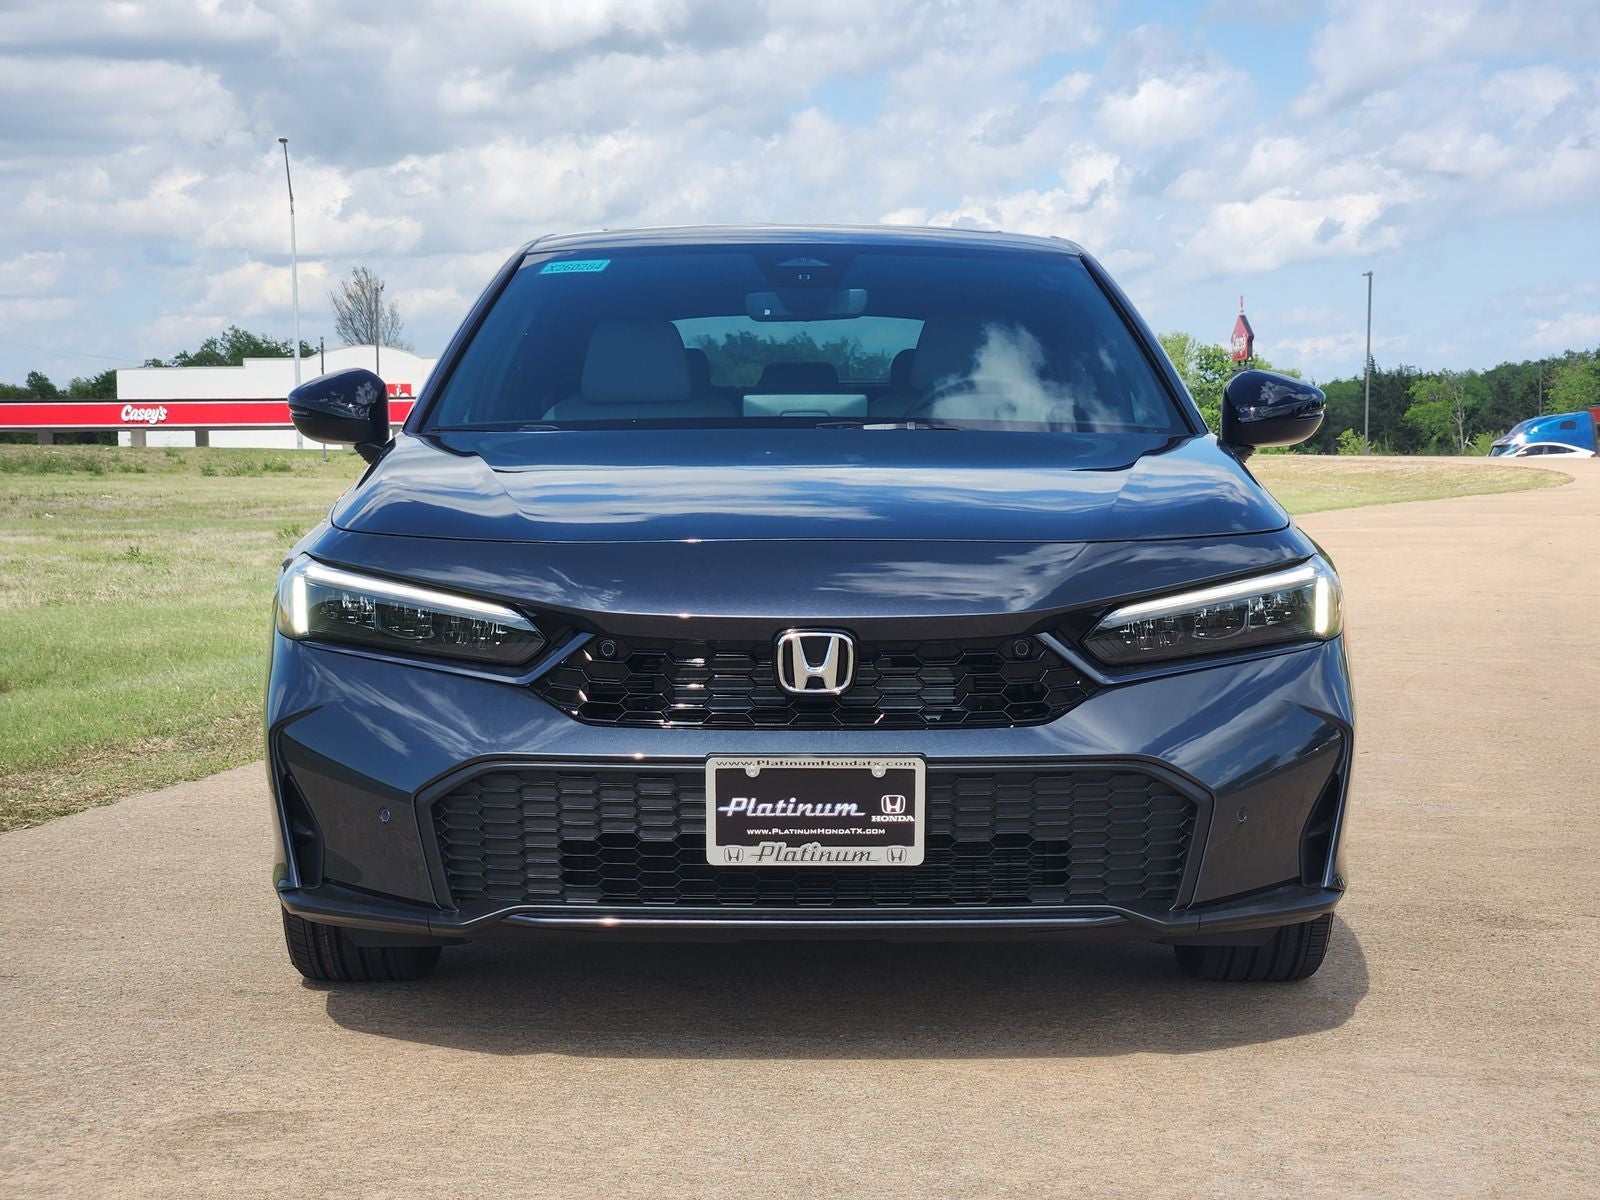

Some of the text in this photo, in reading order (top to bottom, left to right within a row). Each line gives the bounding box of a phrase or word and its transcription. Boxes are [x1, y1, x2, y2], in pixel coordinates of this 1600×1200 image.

[121, 404, 168, 425] Casey's
[718, 796, 866, 817] Platinum
[871, 815, 915, 823] HONDA
[749, 843, 881, 864] Platinum
